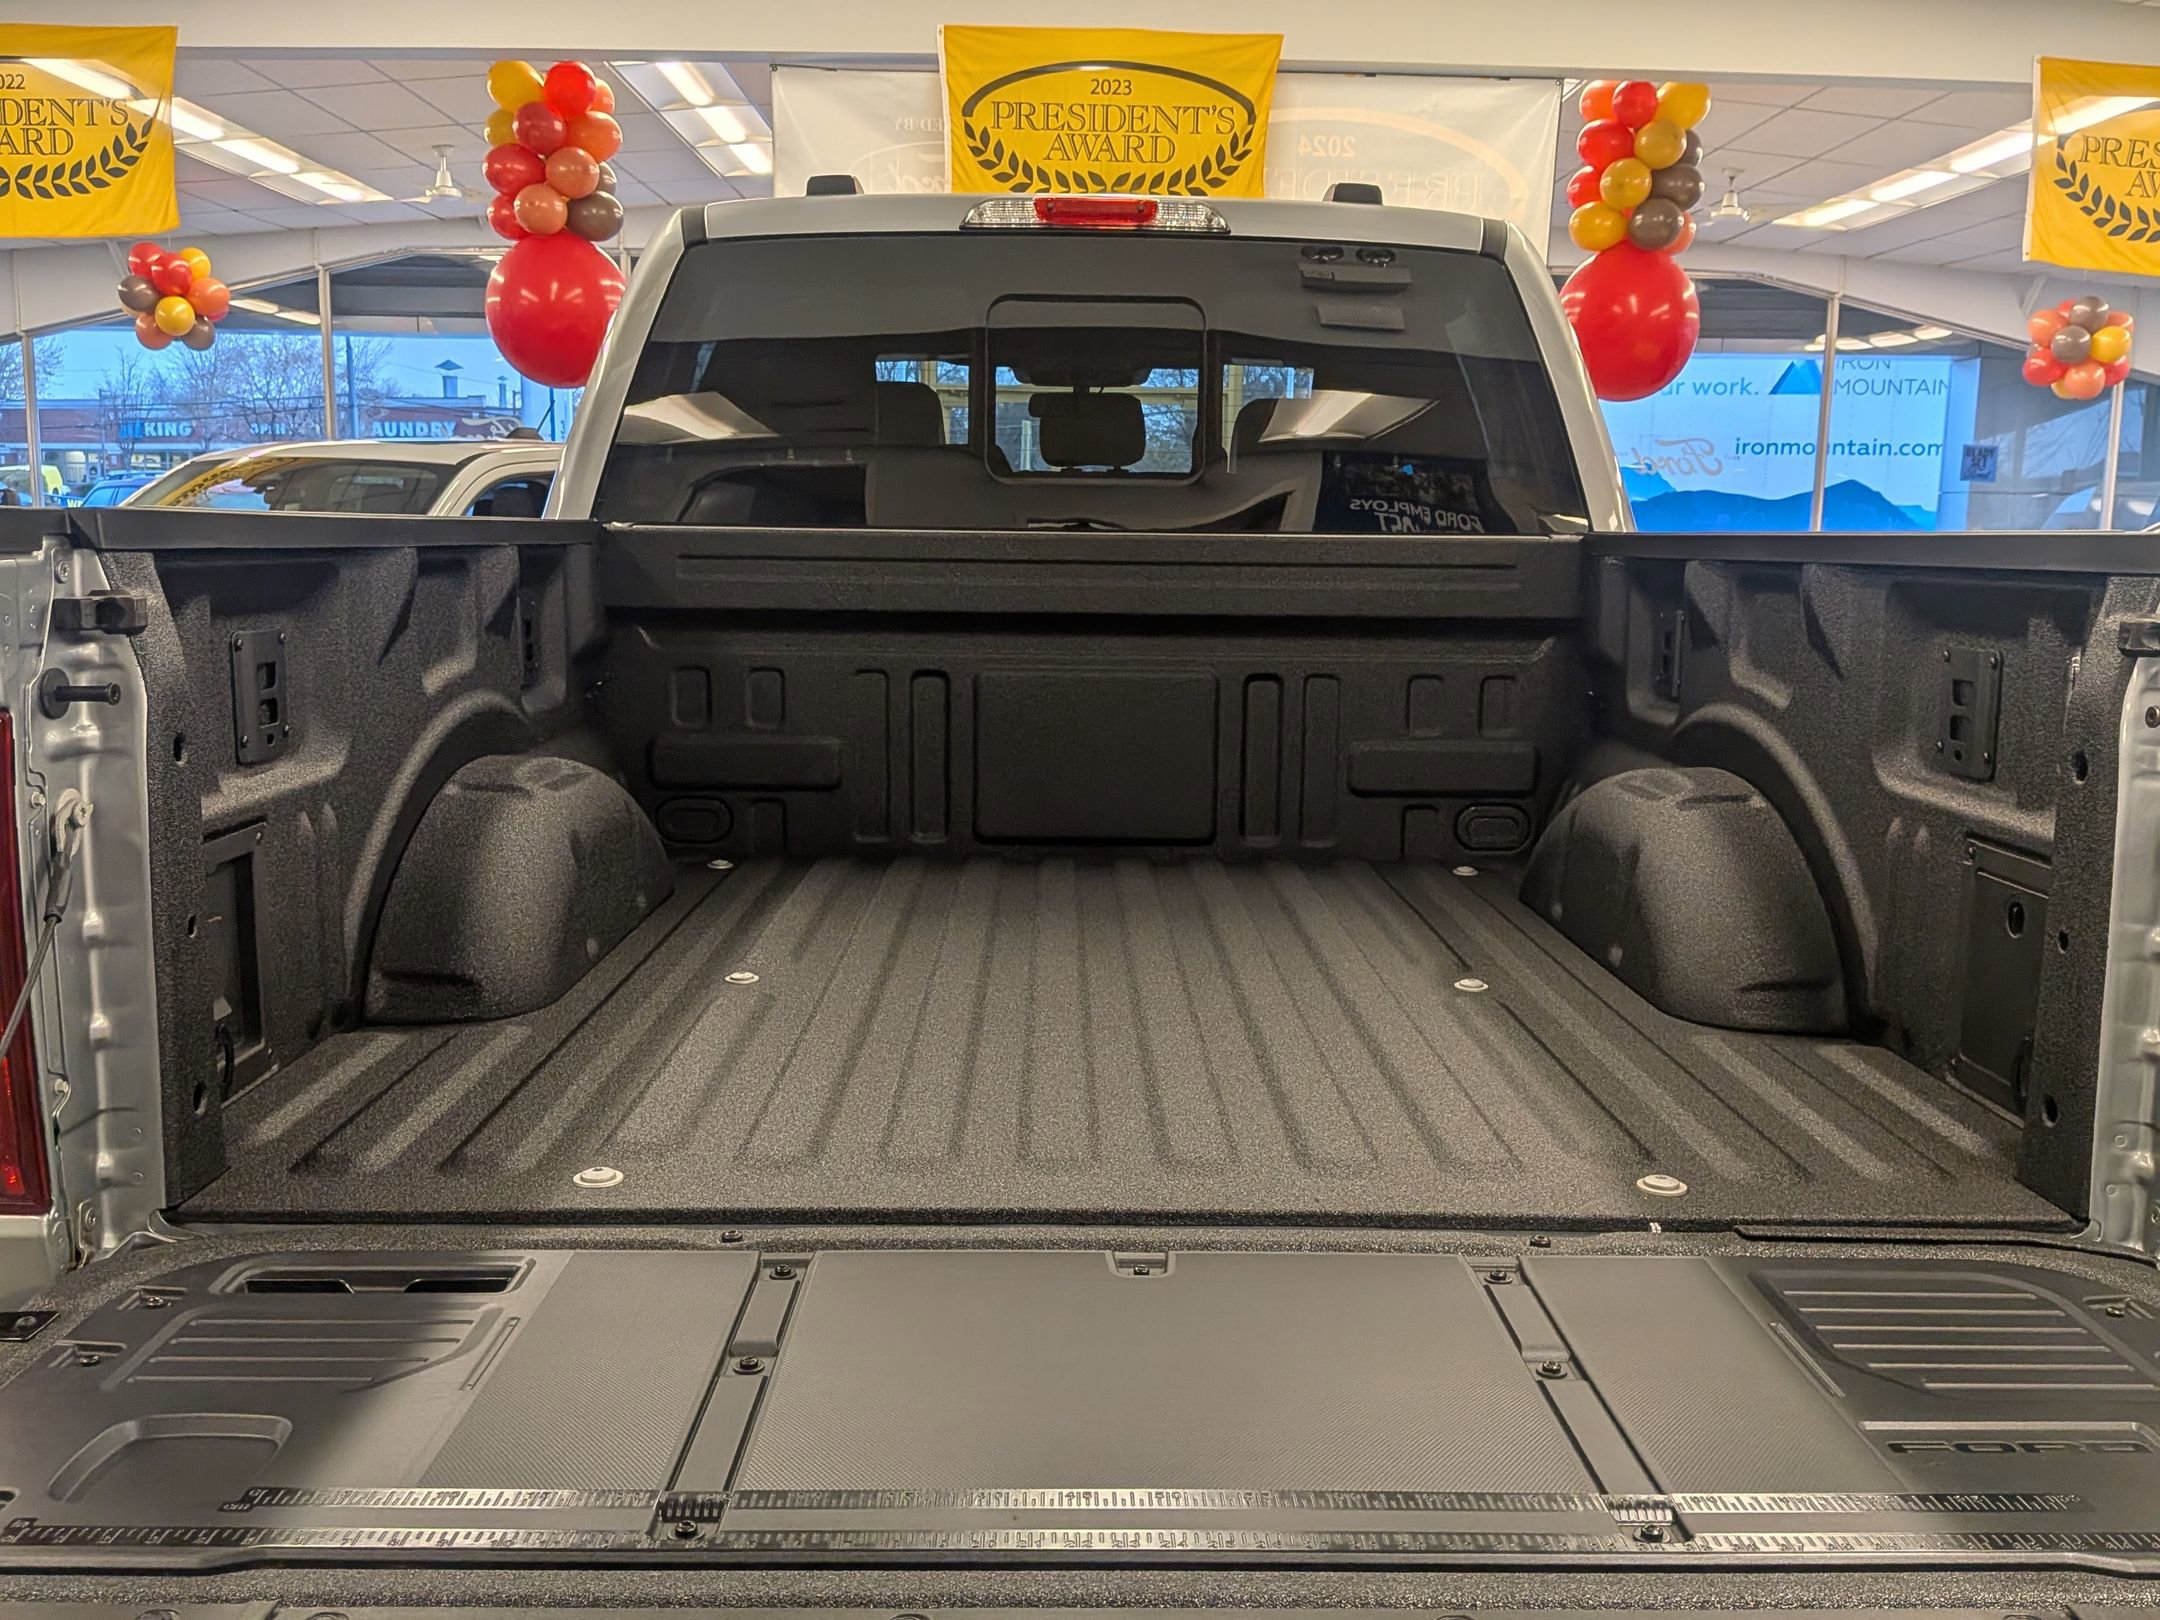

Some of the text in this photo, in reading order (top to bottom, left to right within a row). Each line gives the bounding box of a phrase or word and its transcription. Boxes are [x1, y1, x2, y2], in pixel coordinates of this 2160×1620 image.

[1090, 78, 1133, 96] 2023
[991, 101, 1236, 134] PRESIDENT'S
[1043, 134, 1176, 163] AWARD
[1693, 377, 1760, 395] work.
[144, 422, 193, 437] KING
[1735, 437, 1943, 456] ironmontain.com
